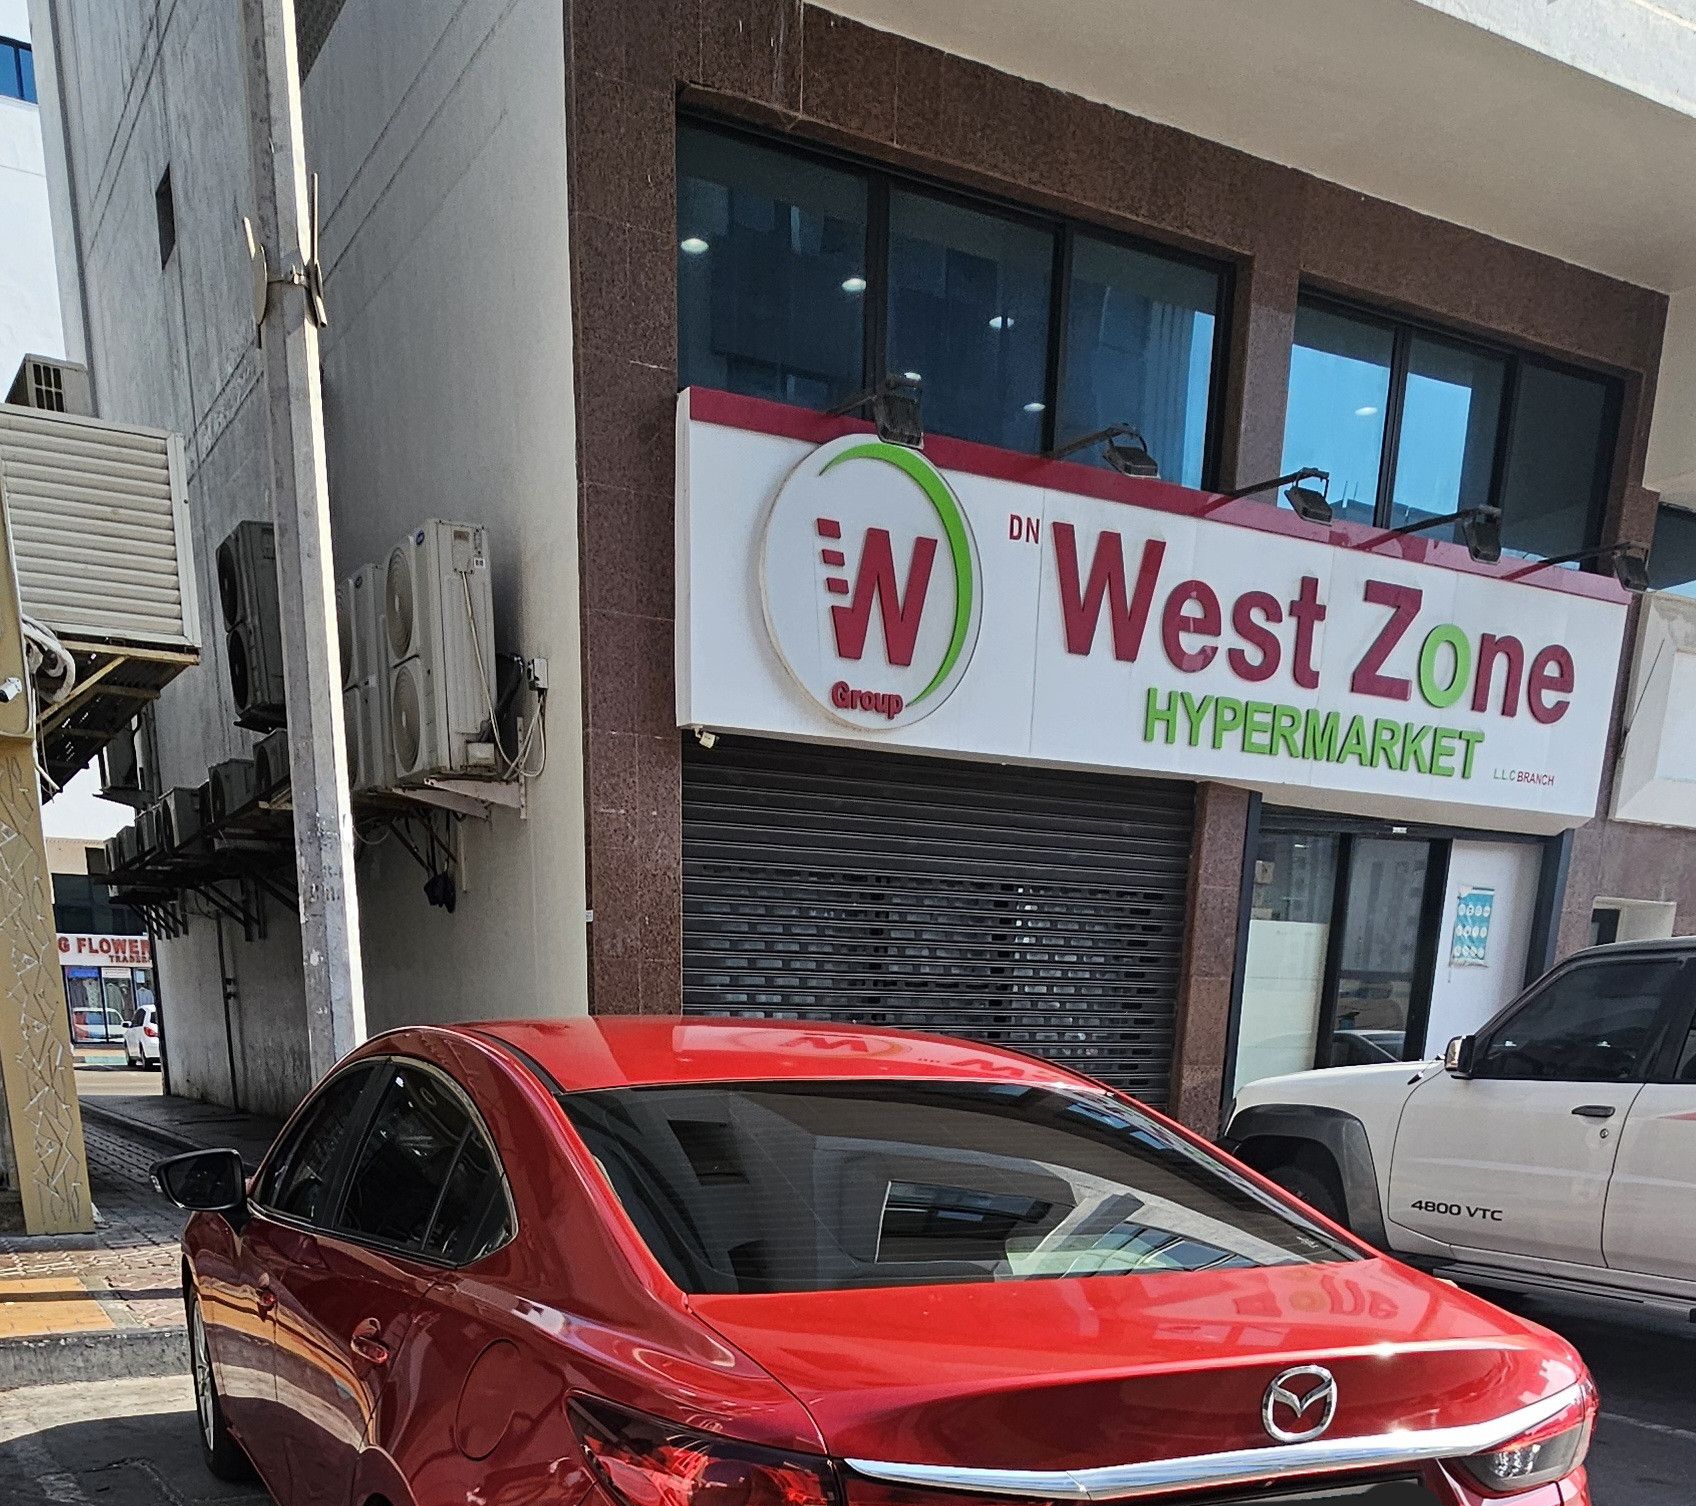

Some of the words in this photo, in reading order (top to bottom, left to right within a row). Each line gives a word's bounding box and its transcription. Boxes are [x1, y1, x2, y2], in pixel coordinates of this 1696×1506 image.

[1009, 513, 1041, 544] DN
[1052, 521, 1327, 689] West
[1350, 579, 1575, 724] Zone
[831, 681, 904, 720] Group
[1144, 687, 1486, 780] HYPERMARKET
[1516, 770, 1555, 786] BRANCH
[1411, 1200, 1461, 1216] 4800
[1465, 1205, 1503, 1221] VTC
